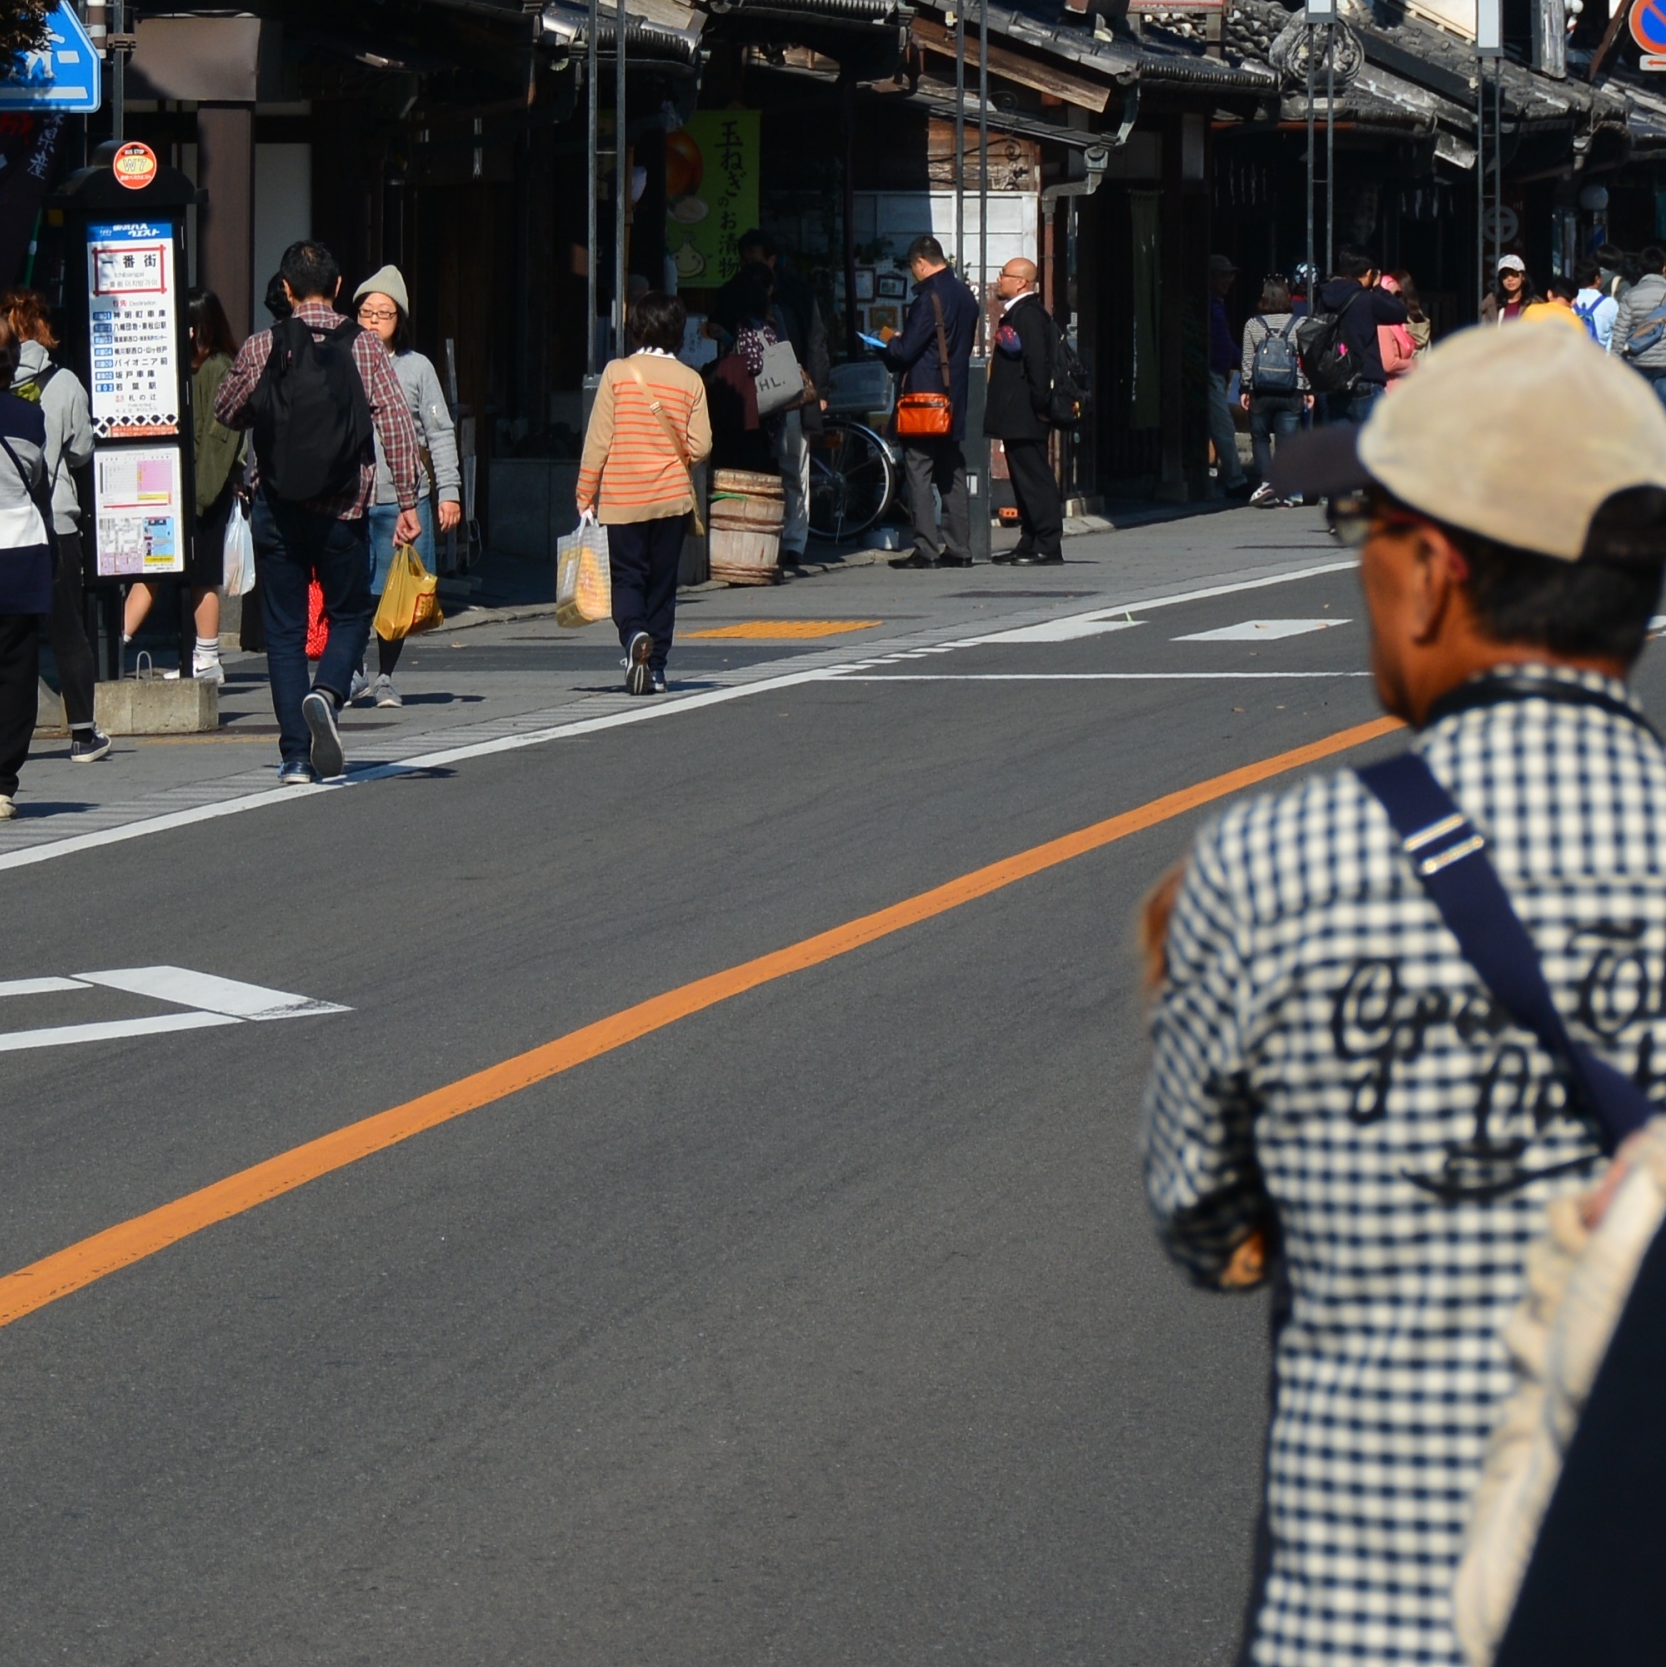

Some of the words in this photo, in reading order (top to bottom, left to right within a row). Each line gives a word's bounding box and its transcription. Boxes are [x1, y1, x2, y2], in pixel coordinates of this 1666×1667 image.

[123, 158, 148, 172] W7
[714, 120, 747, 279] 玉ねぎのお漬物
[102, 254, 157, 269] 一番街
